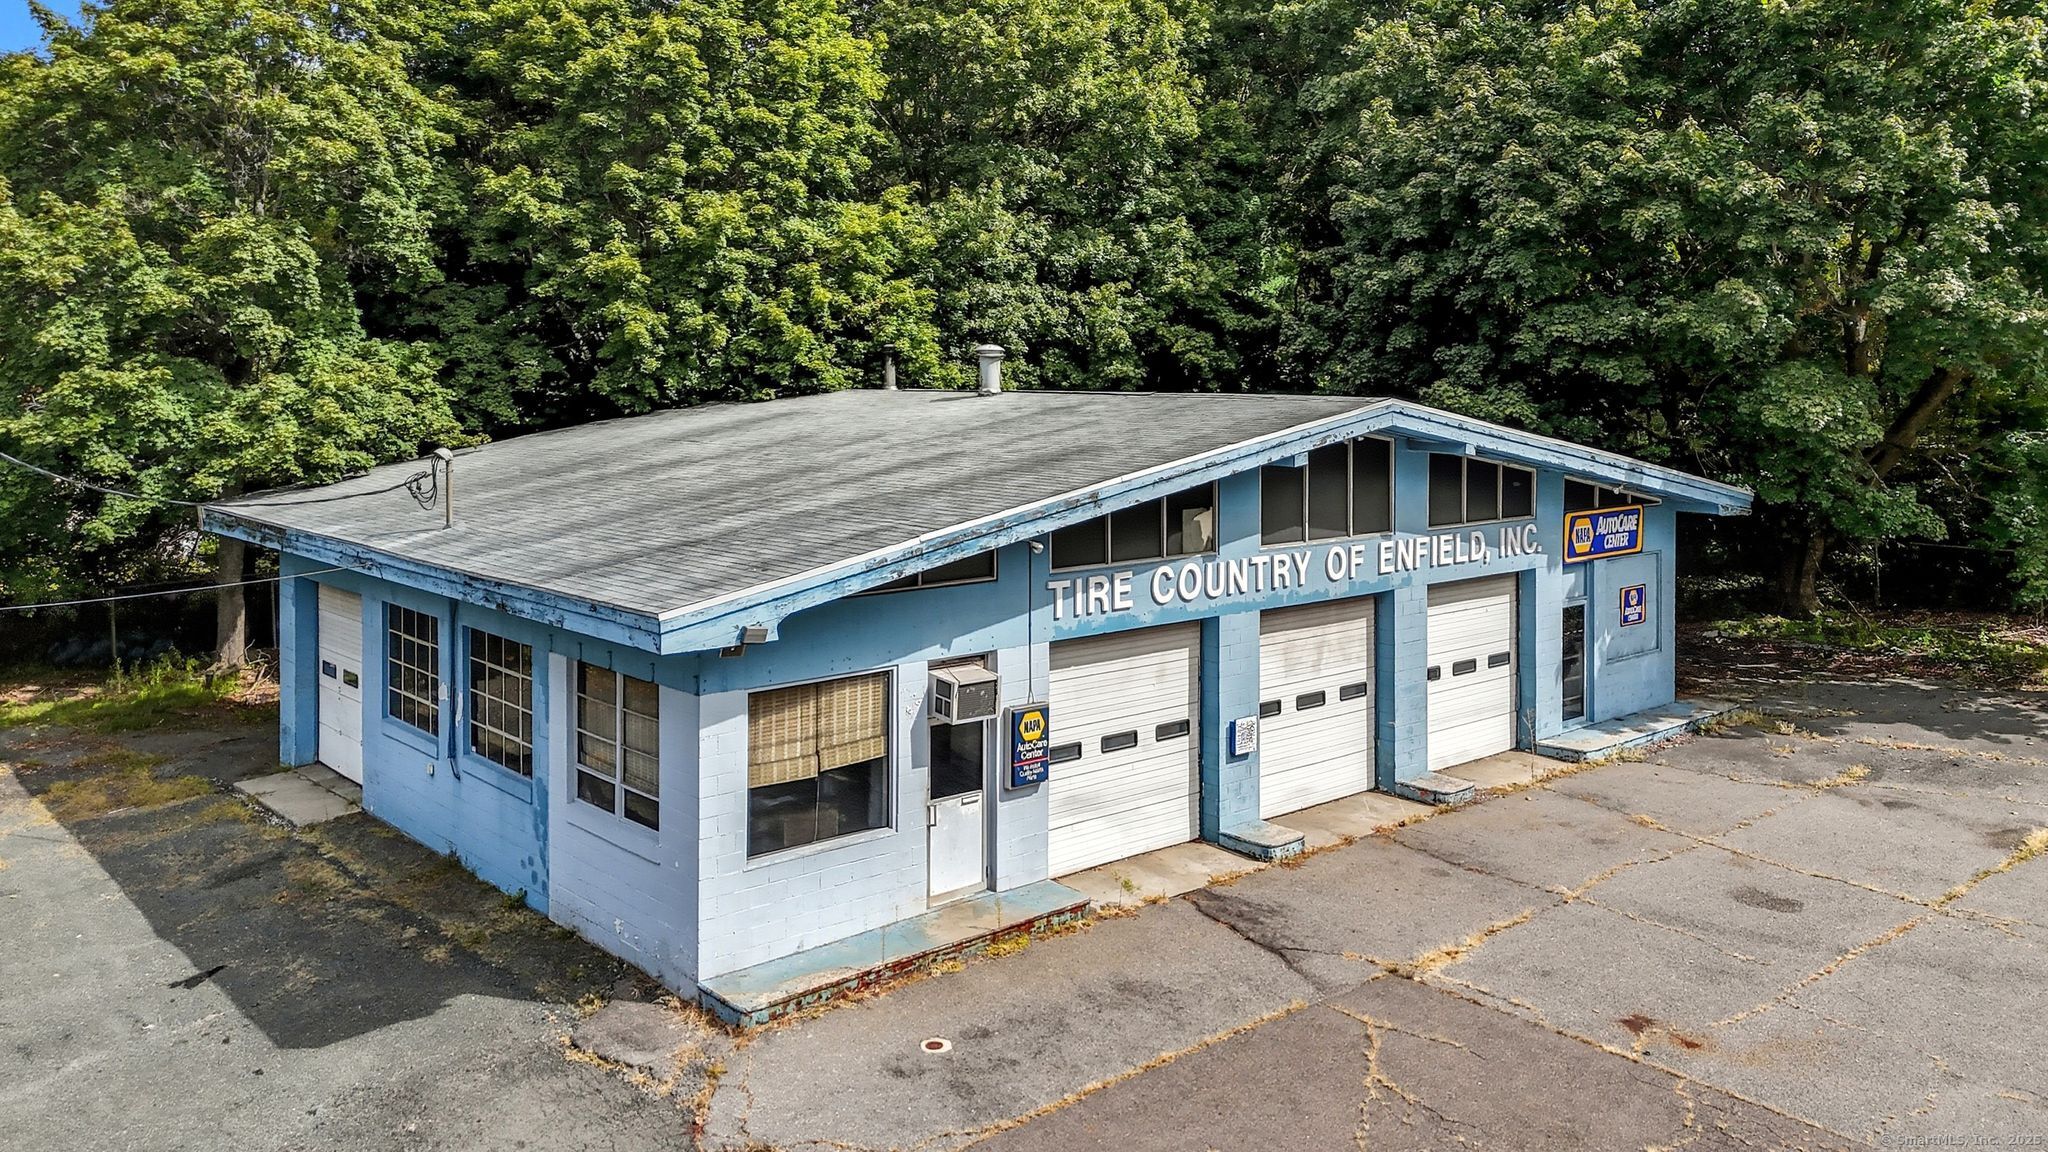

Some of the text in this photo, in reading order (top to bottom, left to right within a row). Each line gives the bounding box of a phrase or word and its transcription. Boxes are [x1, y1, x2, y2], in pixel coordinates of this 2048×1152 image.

[1576, 527, 1591, 544] NAPA
[1604, 532, 1628, 548] CENTER
[1047, 523, 1543, 621] TIRE COUNTRY OF ENFIELD, INC.
[1024, 719, 1041, 733] NAPA
[1021, 749, 1043, 759] Center
